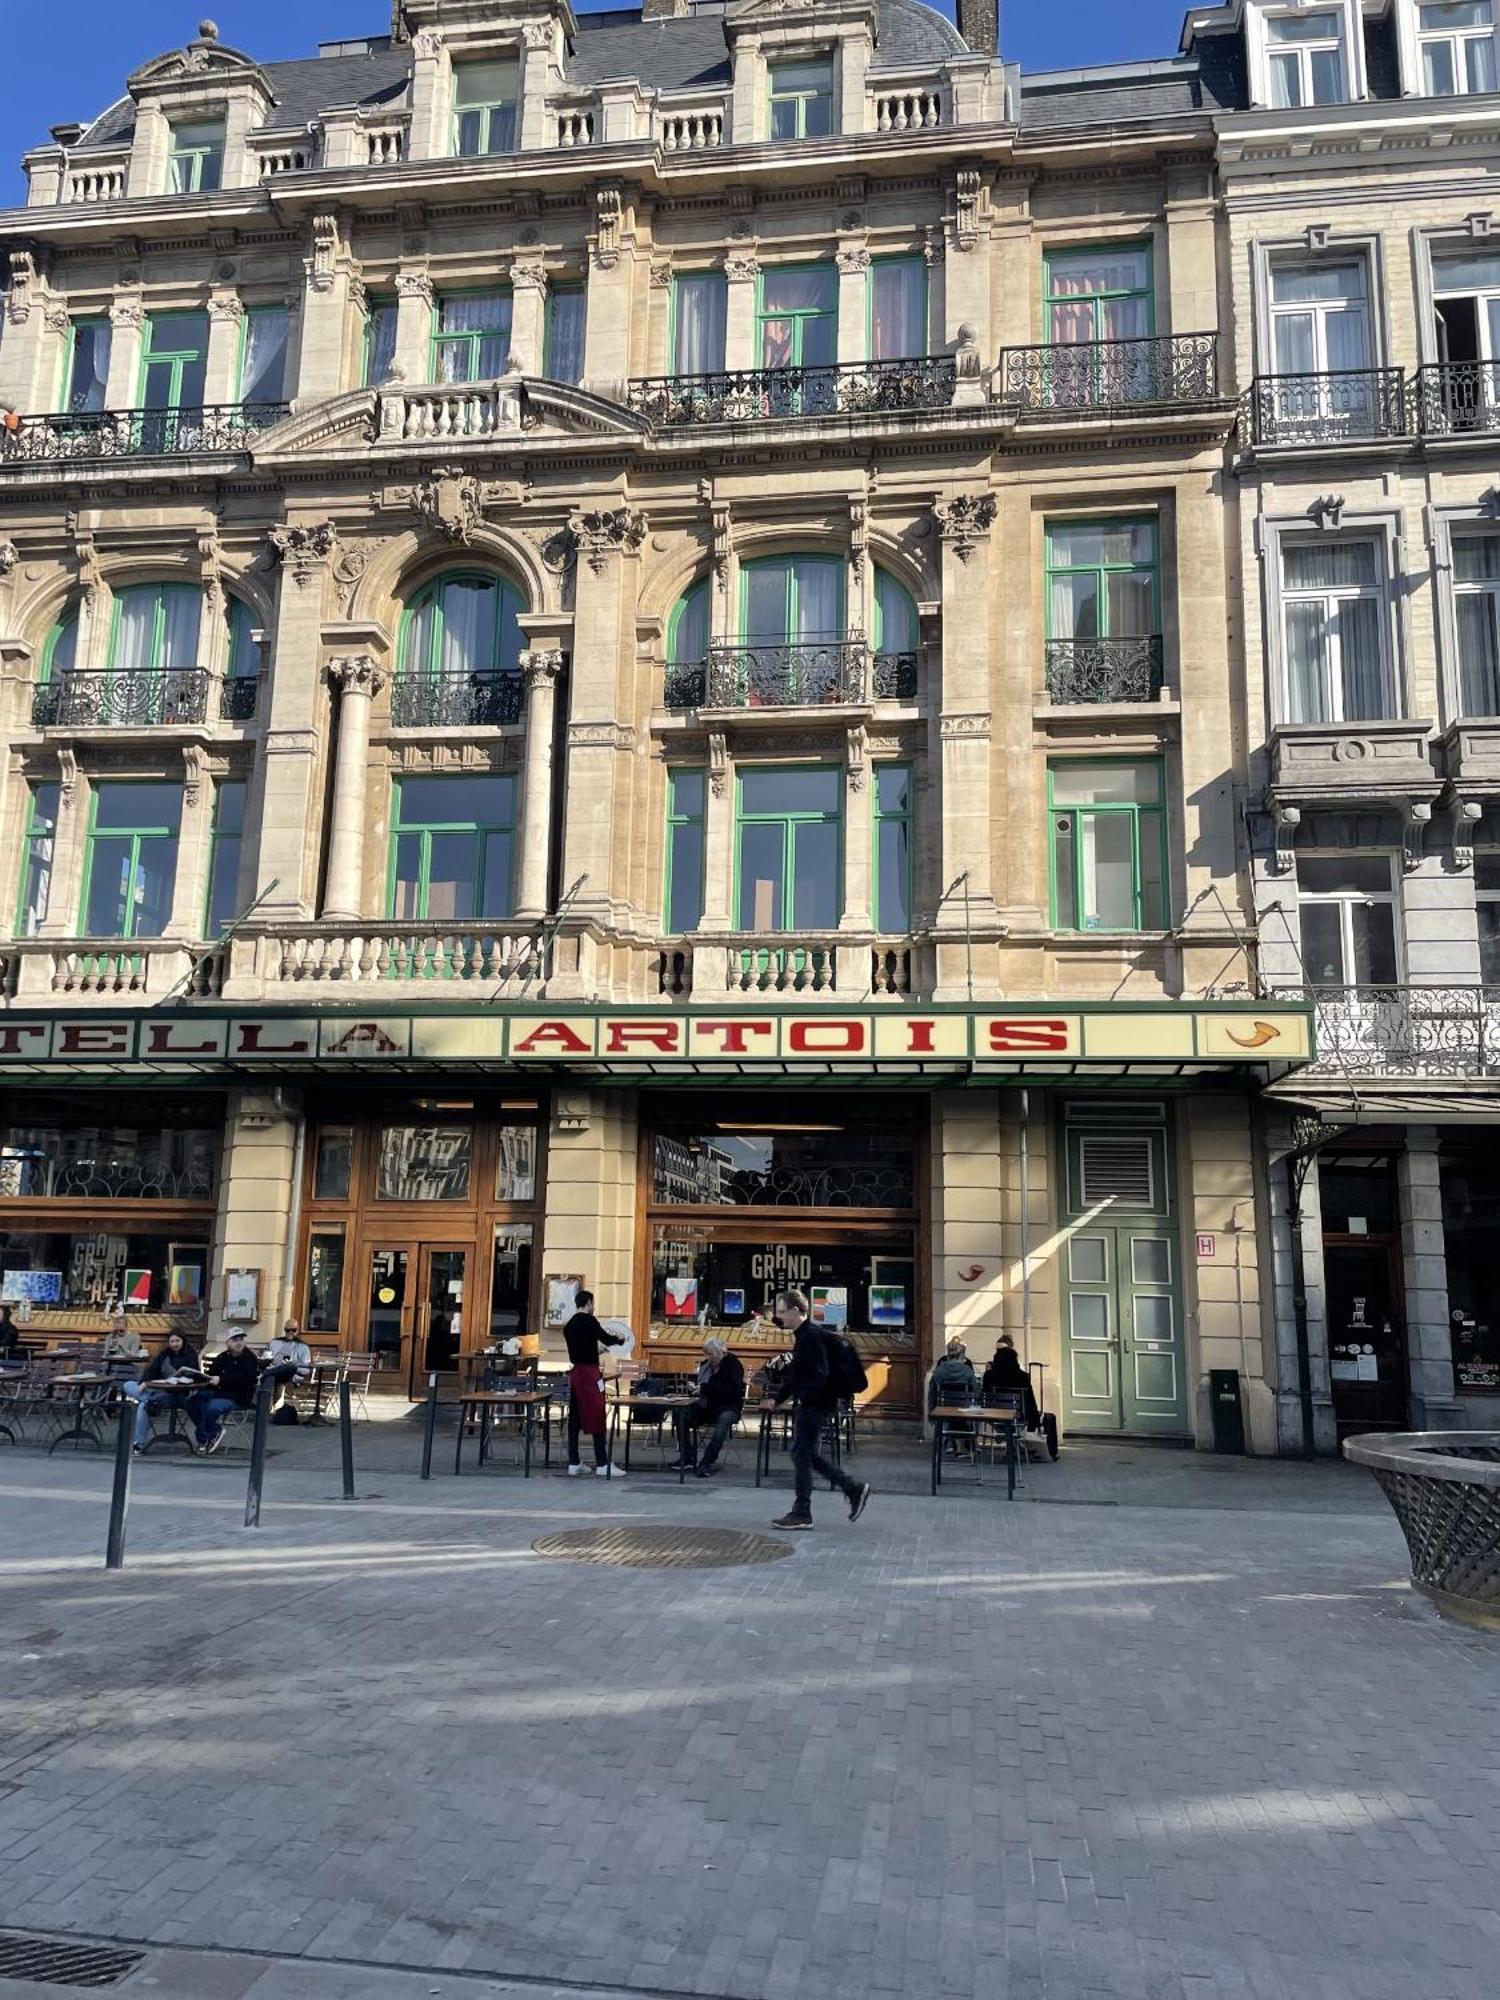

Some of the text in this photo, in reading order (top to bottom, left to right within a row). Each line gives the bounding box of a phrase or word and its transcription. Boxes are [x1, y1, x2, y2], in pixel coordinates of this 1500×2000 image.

[514, 1021, 1068, 1052] ARTOIS
[751, 1244, 811, 1279] GRAND
[1201, 1239, 1212, 1253] H
